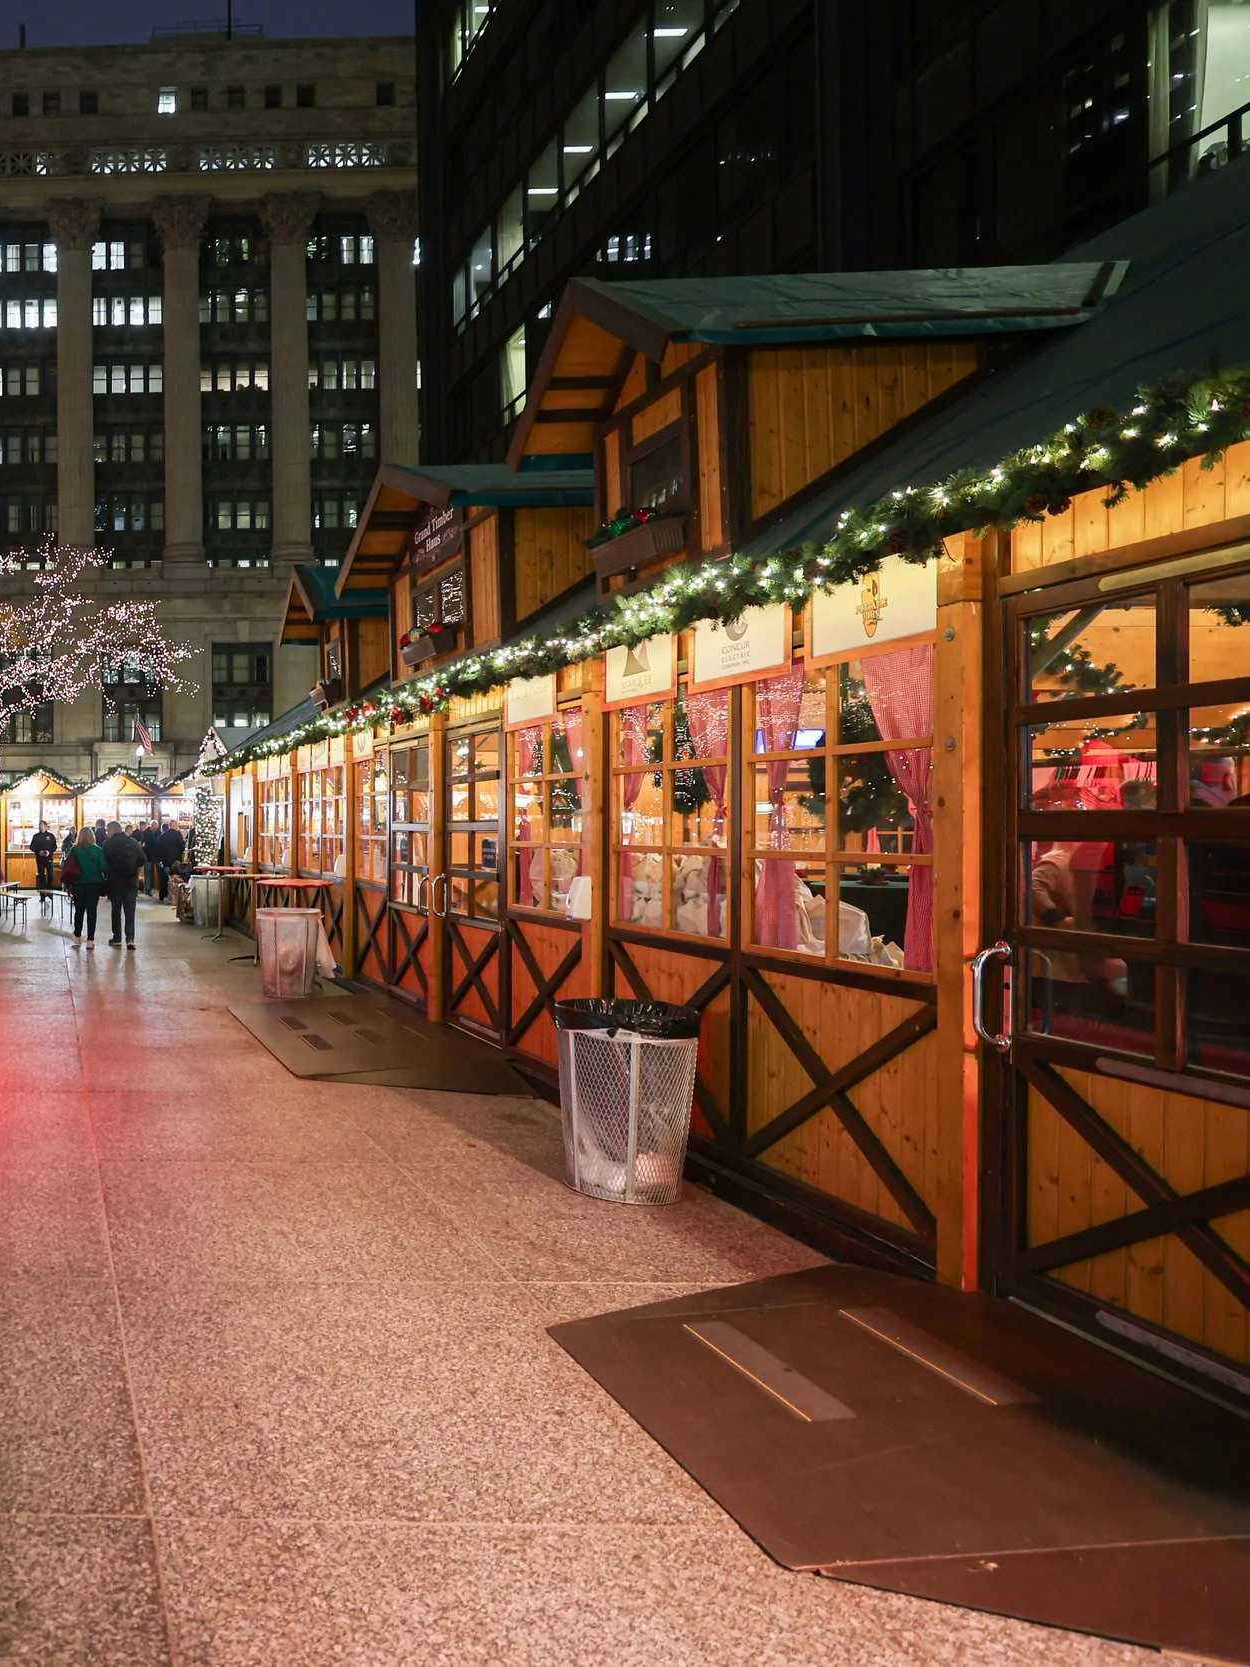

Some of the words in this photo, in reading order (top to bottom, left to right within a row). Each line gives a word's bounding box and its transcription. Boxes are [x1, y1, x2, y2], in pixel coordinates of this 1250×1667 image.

[415, 522, 431, 545] Grand
[431, 508, 454, 532] Timber
[426, 534, 441, 552] Haus
[721, 640, 750, 655] CONCUR
[721, 651, 750, 663] ELECTRIC
[621, 676, 653, 690] MARQUEE
